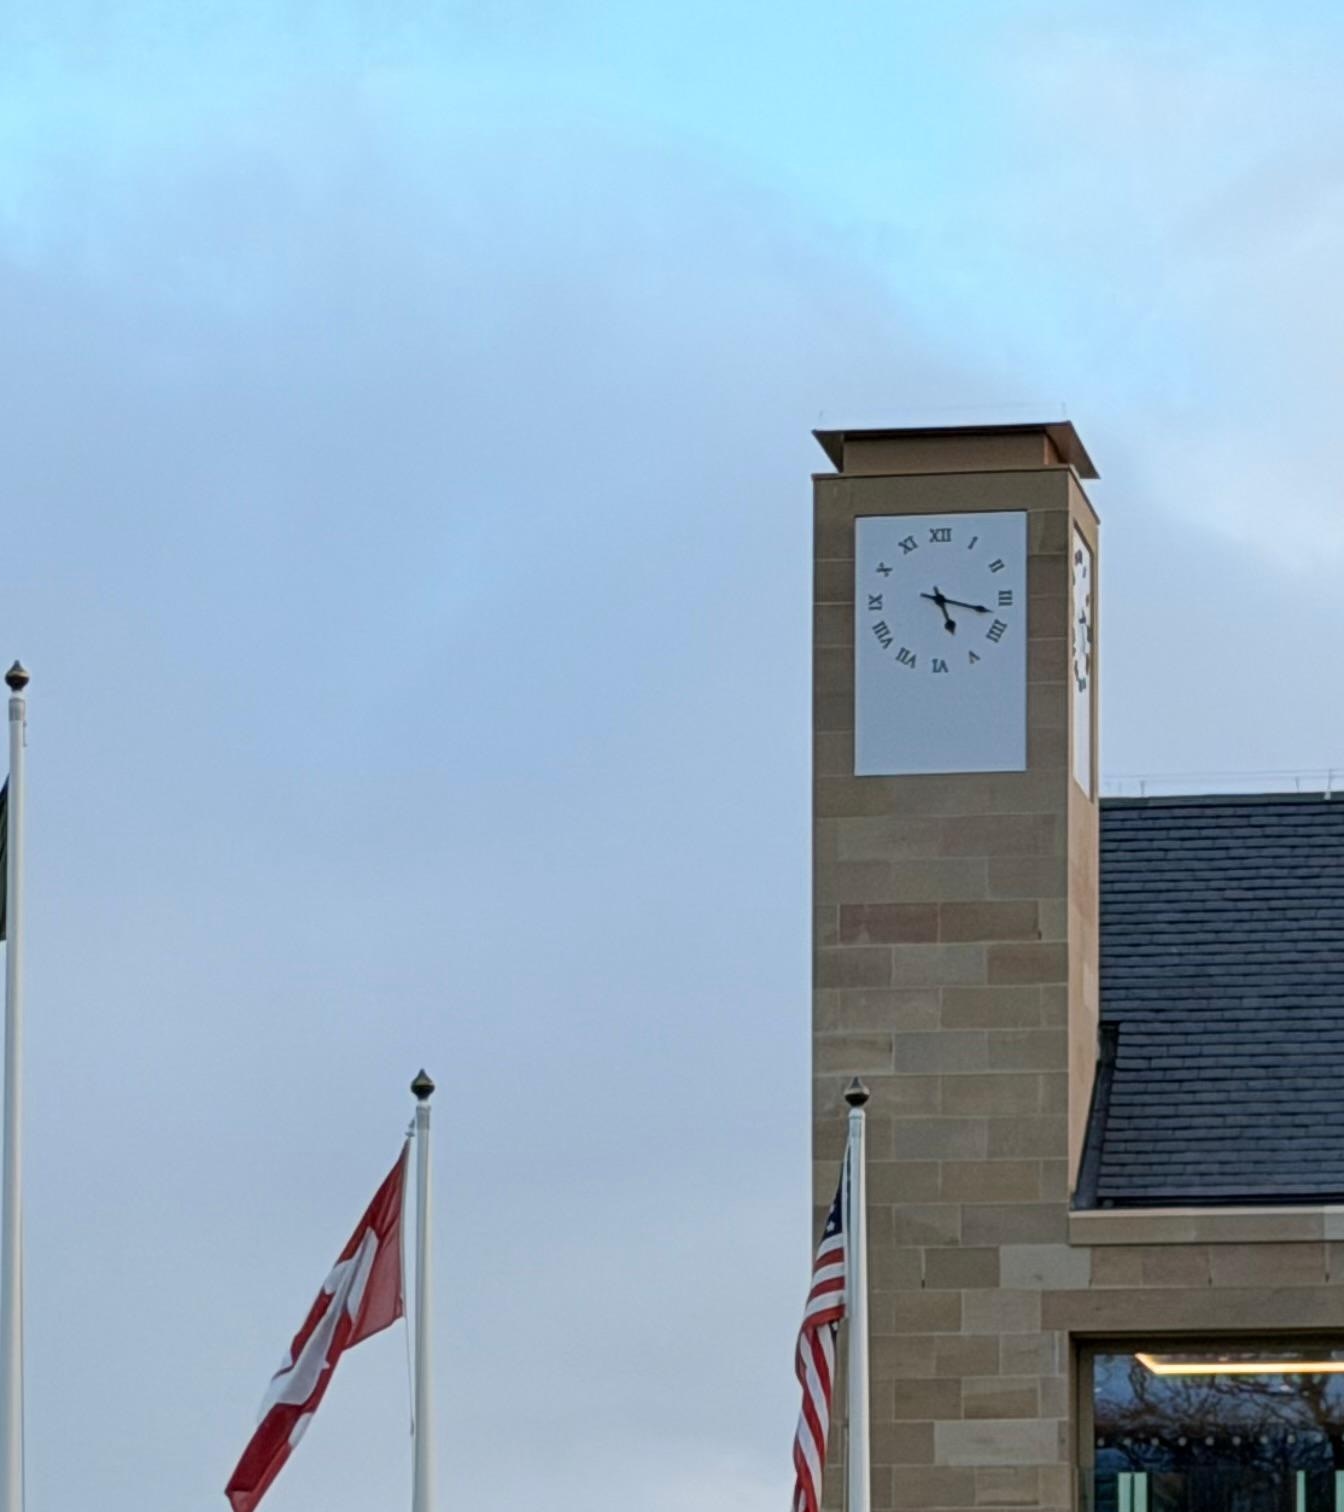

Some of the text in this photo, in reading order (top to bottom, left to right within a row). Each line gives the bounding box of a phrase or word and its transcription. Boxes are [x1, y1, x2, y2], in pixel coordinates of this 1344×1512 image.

[929, 528, 952, 543] XII
[967, 535, 979, 550] I
[898, 536, 919, 555] XI
[876, 562, 893, 577] X
[988, 558, 1005, 574] II
[868, 594, 883, 611] IX
[998, 590, 1013, 607] III
[872, 620, 893, 649] VIII
[986, 619, 1007, 643] IIII
[896, 647, 917, 669] VII
[968, 650, 981, 664] V
[932, 658, 949, 673] VI
